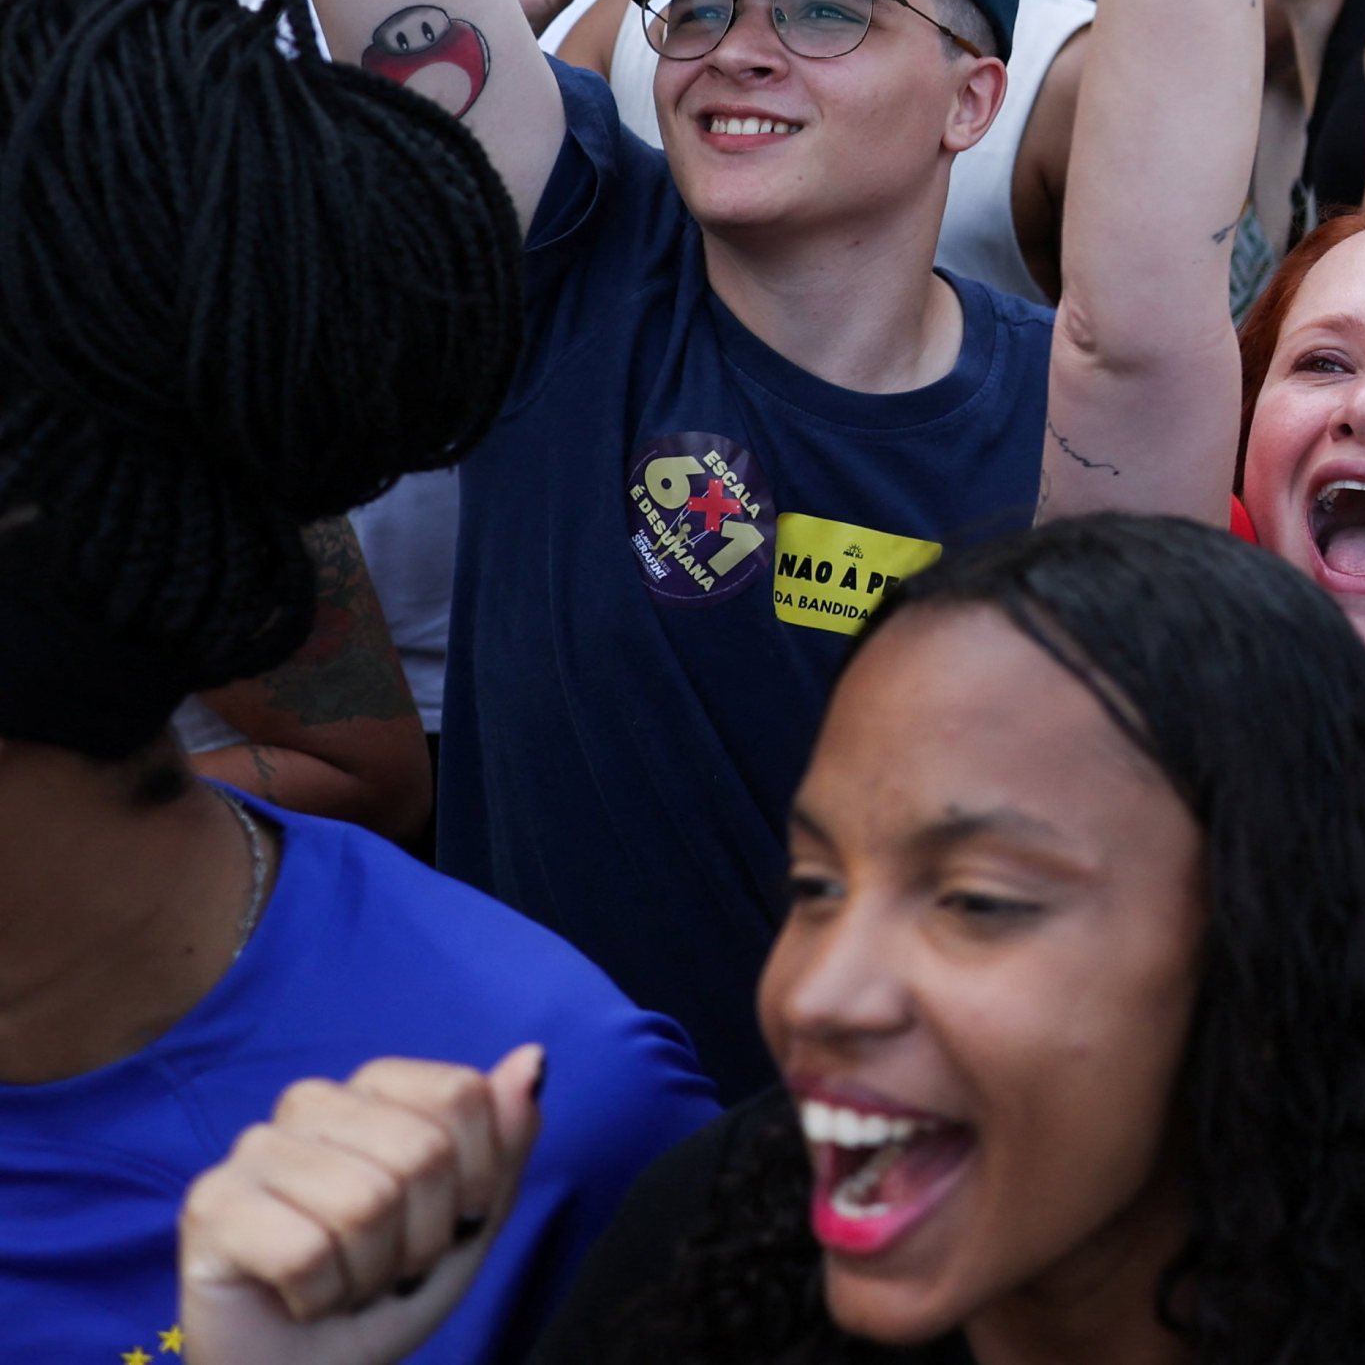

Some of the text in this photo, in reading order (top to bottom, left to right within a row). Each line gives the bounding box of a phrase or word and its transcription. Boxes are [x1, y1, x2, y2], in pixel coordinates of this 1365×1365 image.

[703, 450, 761, 520] ESCALA
[630, 485, 717, 592] É DESUMANA
[631, 534, 670, 581] SERAFINI
[777, 552, 833, 584] NÃO
[839, 562, 858, 591] À
[774, 591, 869, 621] DA BANDIDA
